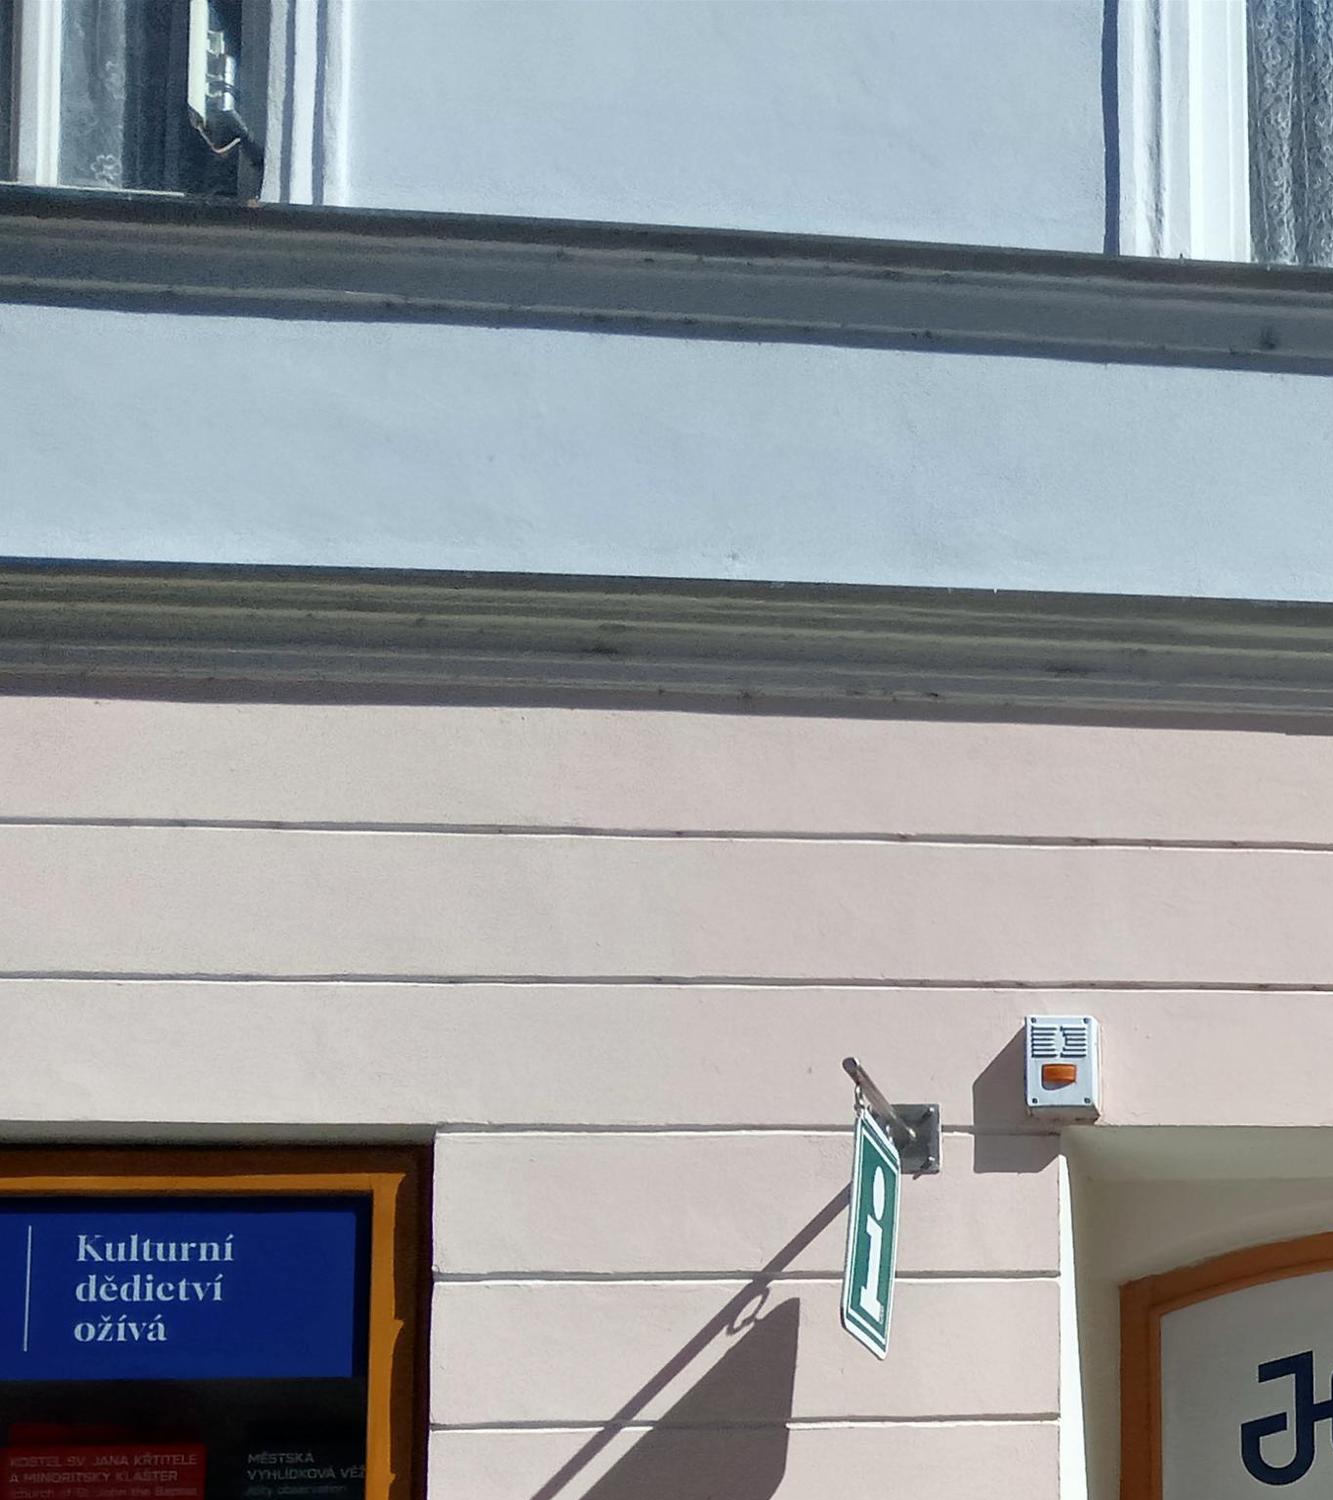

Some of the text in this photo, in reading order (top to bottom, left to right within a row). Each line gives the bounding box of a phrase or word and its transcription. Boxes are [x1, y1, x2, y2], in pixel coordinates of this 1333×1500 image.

[76, 1233, 234, 1263] Kulturní
[76, 1274, 223, 1303] dědictví
[74, 1312, 167, 1344] ožívá
[94, 1455, 129, 1466] JANA
[134, 1452, 197, 1466] KŘTITELE
[247, 1451, 315, 1464] MĚSTSKÁ
[9, 1472, 18, 1482] A
[247, 1466, 337, 1480] VYHLÍDKOVÁ
